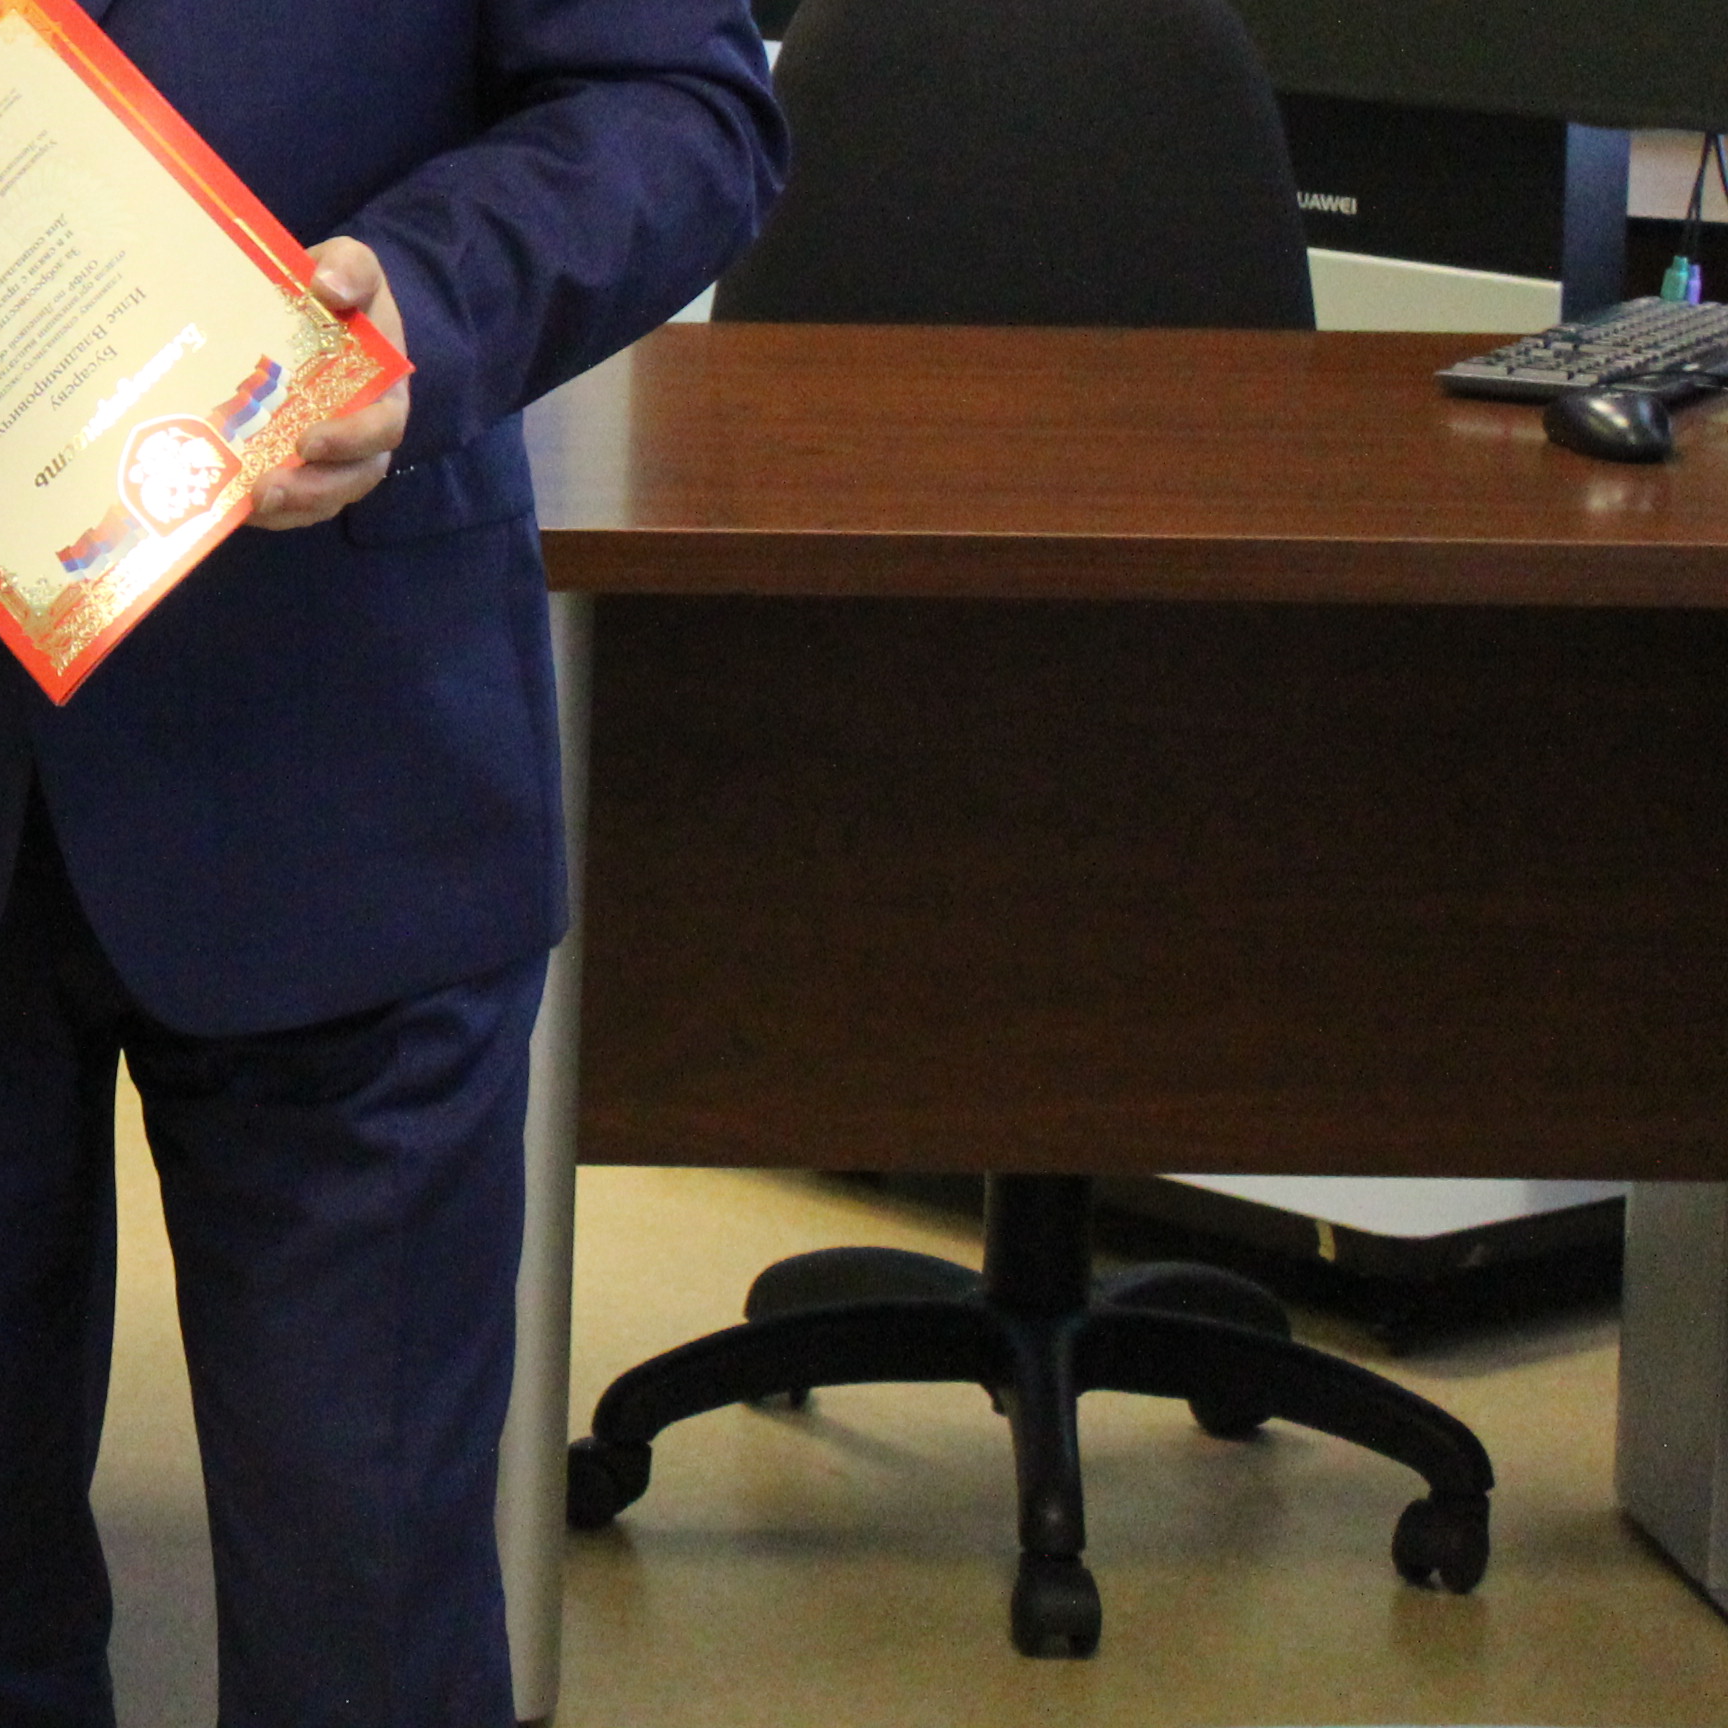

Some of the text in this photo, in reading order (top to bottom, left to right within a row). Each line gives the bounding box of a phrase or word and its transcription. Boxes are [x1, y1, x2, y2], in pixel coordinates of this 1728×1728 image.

[1296, 190, 1357, 215] UAWEI
[44, 212, 69, 238] Дня
[26, 245, 56, 277] связи
[64, 245, 80, 261] За
[65, 257, 99, 292] ОПФР
[51, 289, 66, 304] по
[104, 285, 147, 325] Илье
[7, 301, 55, 350] Липецкой
[49, 343, 118, 412] Бусареву
